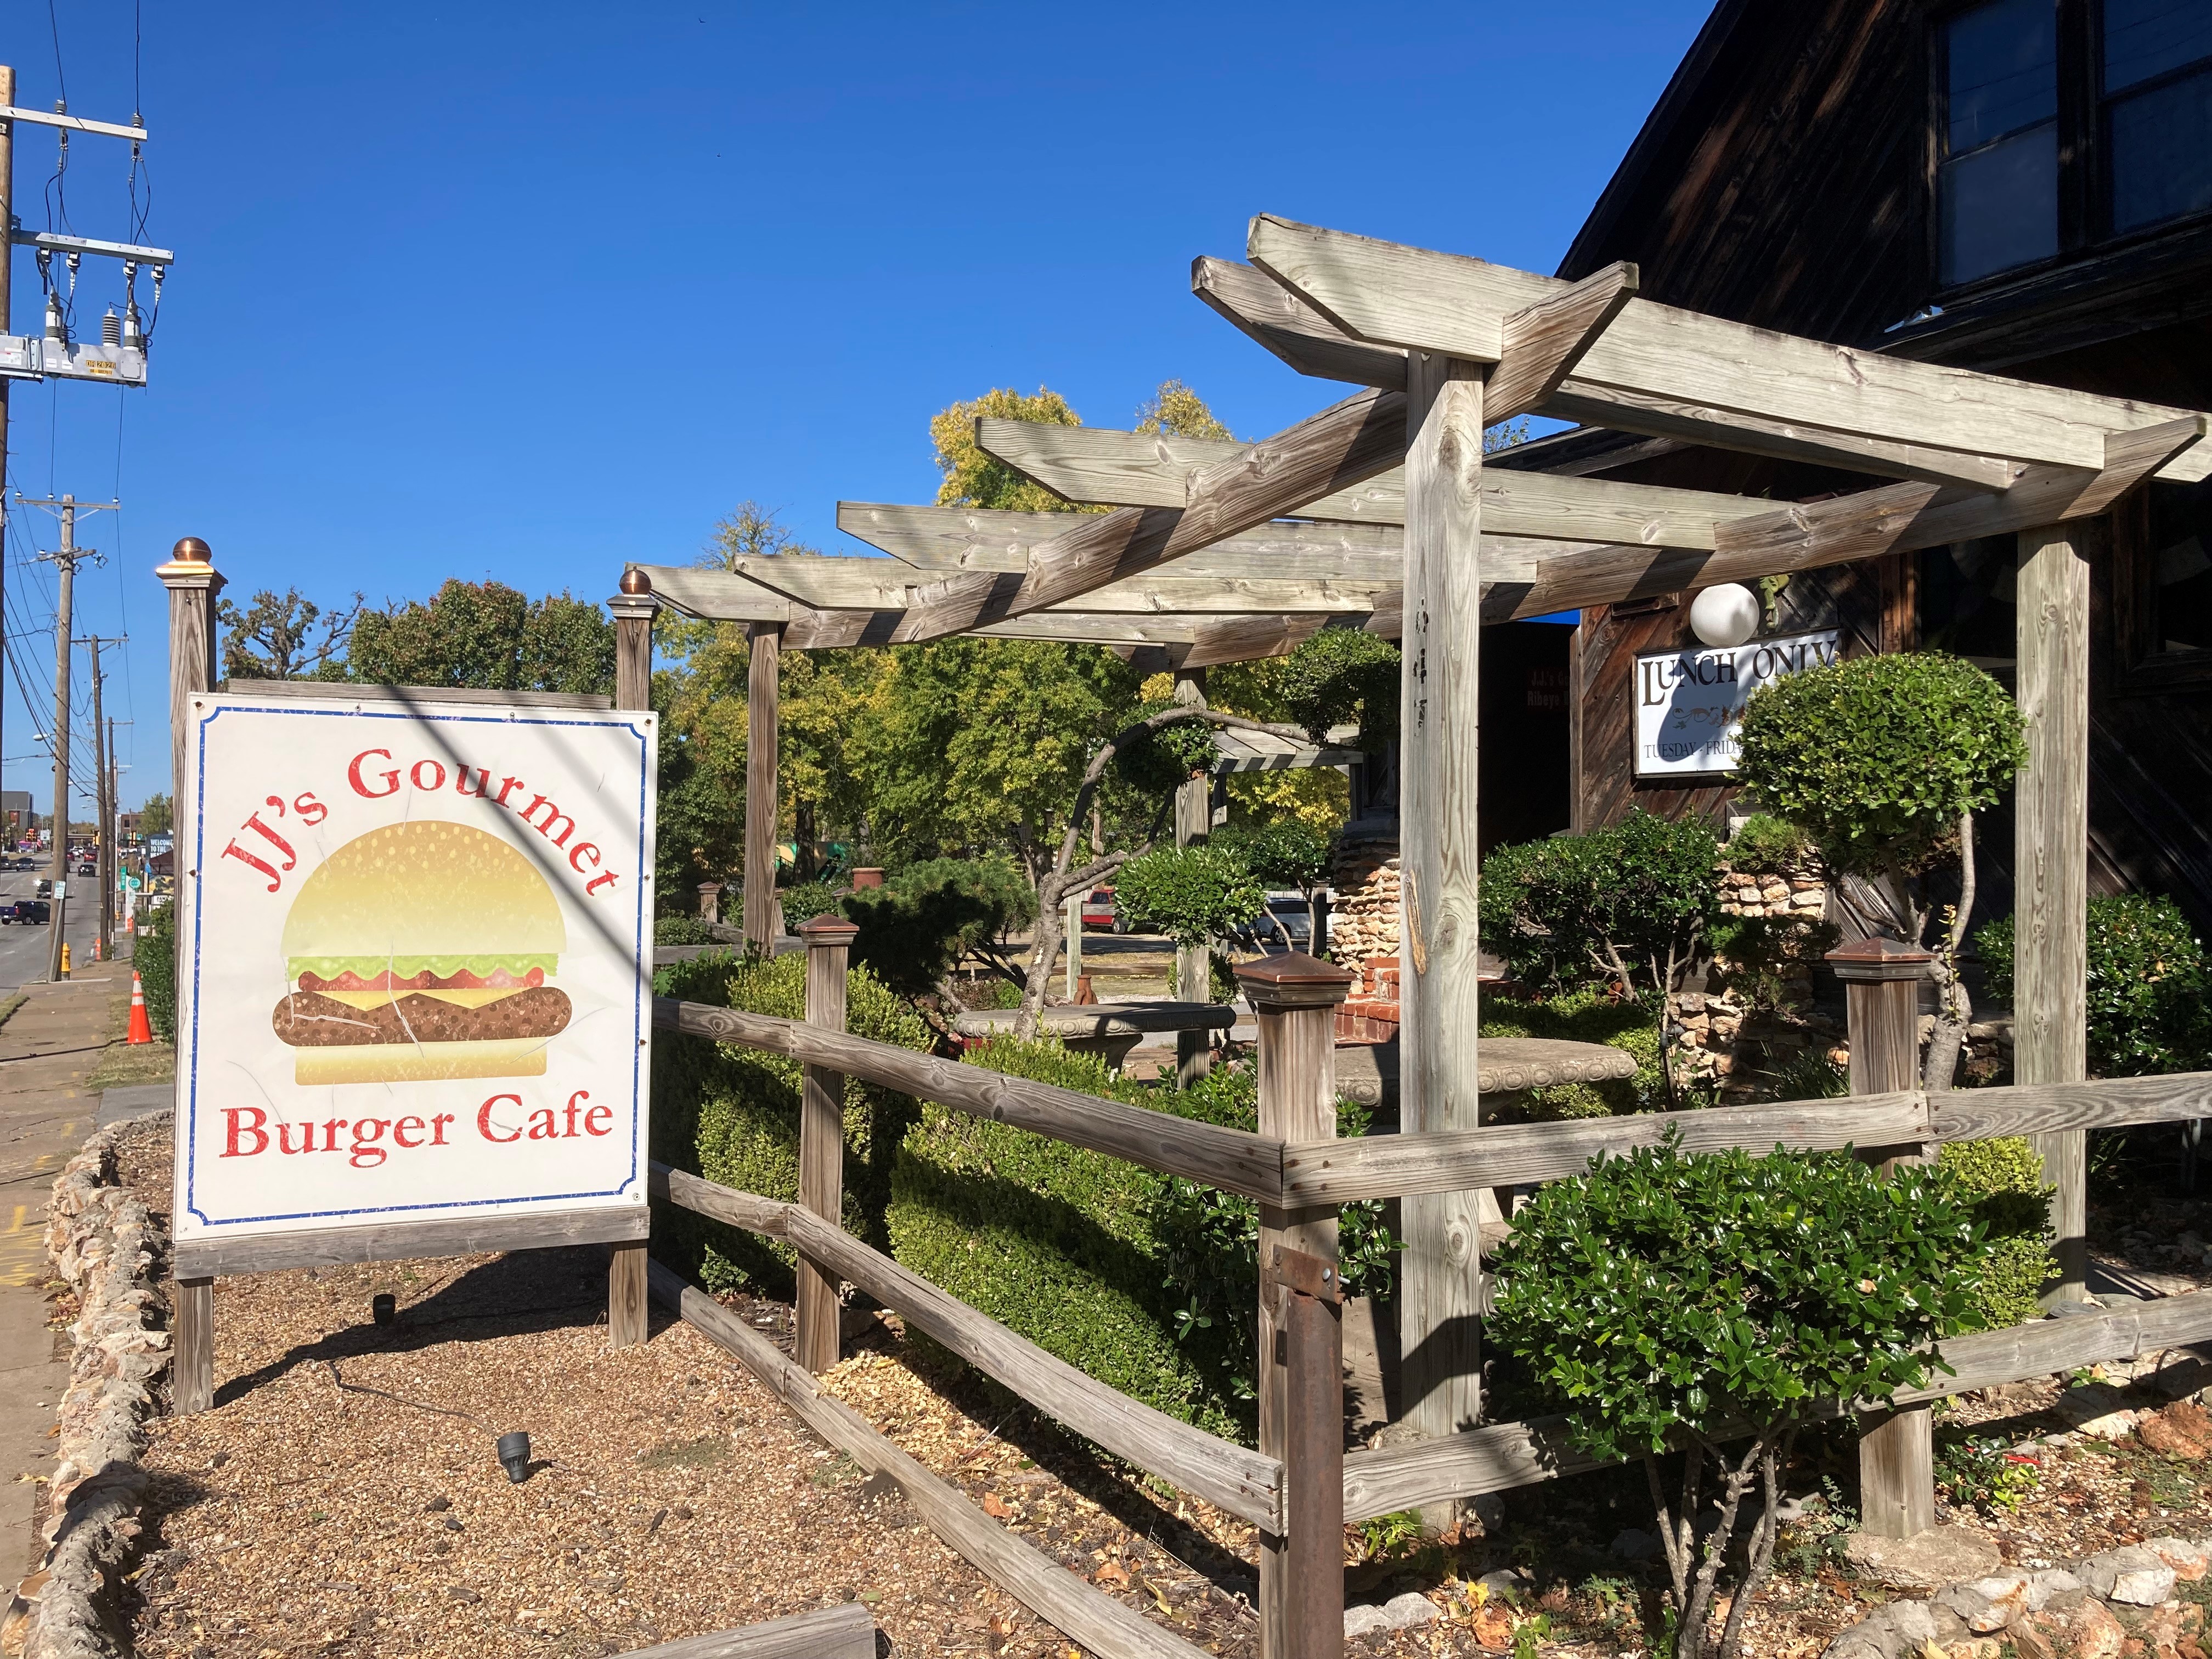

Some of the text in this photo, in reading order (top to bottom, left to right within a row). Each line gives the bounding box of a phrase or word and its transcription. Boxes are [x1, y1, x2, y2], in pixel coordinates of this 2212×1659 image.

[1528, 690, 1560, 709] Ribeye
[1641, 652, 1737, 706] LUNCH
[1644, 742, 1696, 758] TUESDAY
[1706, 740, 1742, 755] FRIDA
[221, 748, 619, 896] JJ's Gourmet
[219, 1090, 614, 1169] Burger Cafe
